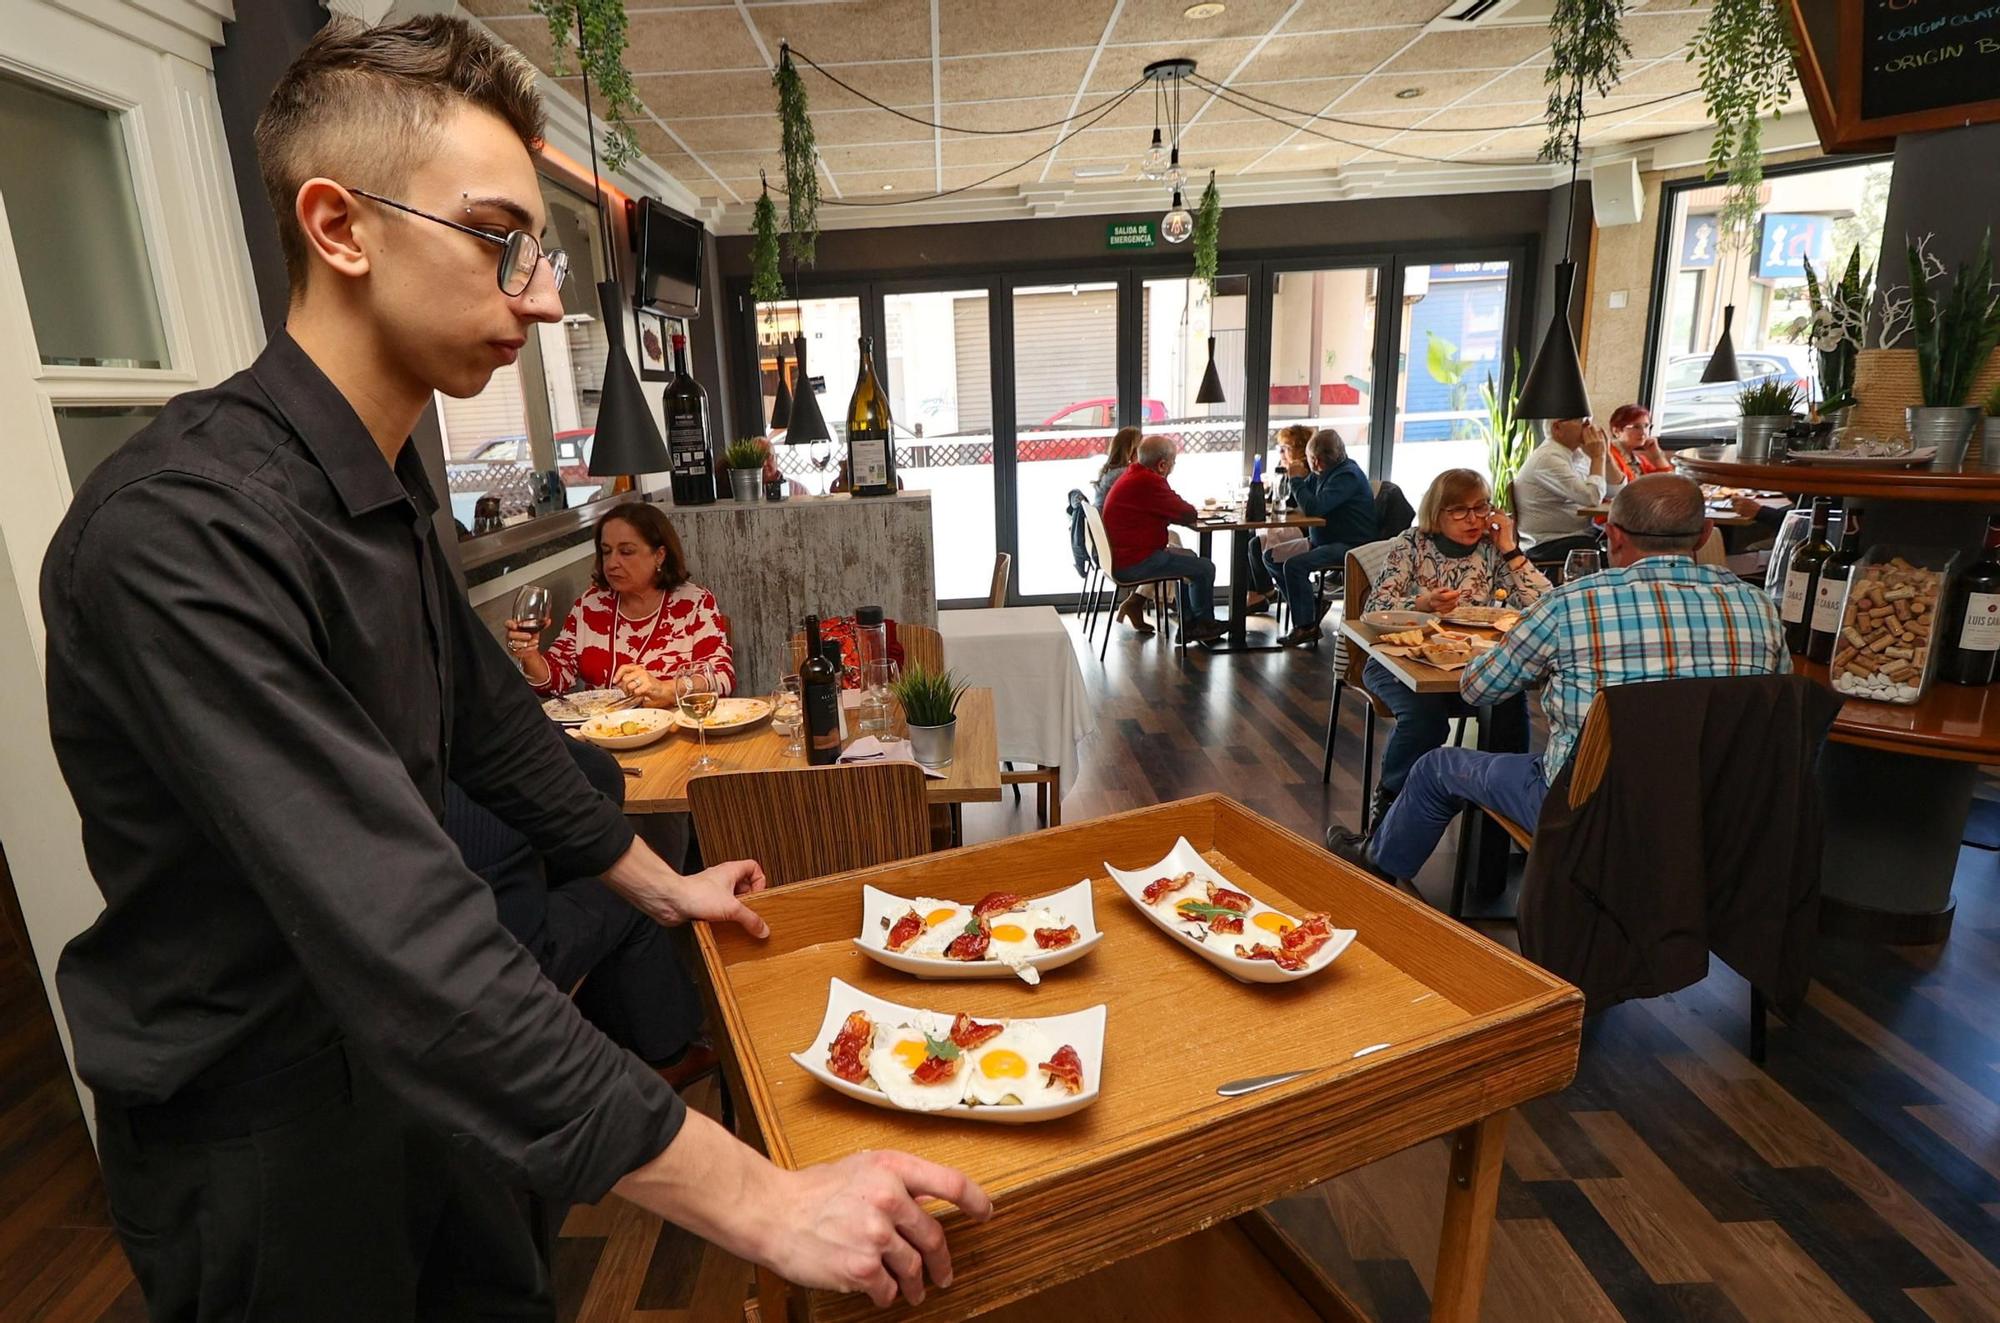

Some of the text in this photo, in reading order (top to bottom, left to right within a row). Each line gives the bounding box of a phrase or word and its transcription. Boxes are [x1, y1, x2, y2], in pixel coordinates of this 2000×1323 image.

[1885, 43, 1963, 72] ORIGIN
[1115, 225, 1147, 235] SALIDA DE
[1110, 234, 1151, 245] EMERGENCIA
[1968, 615, 1986, 625] LUIS
